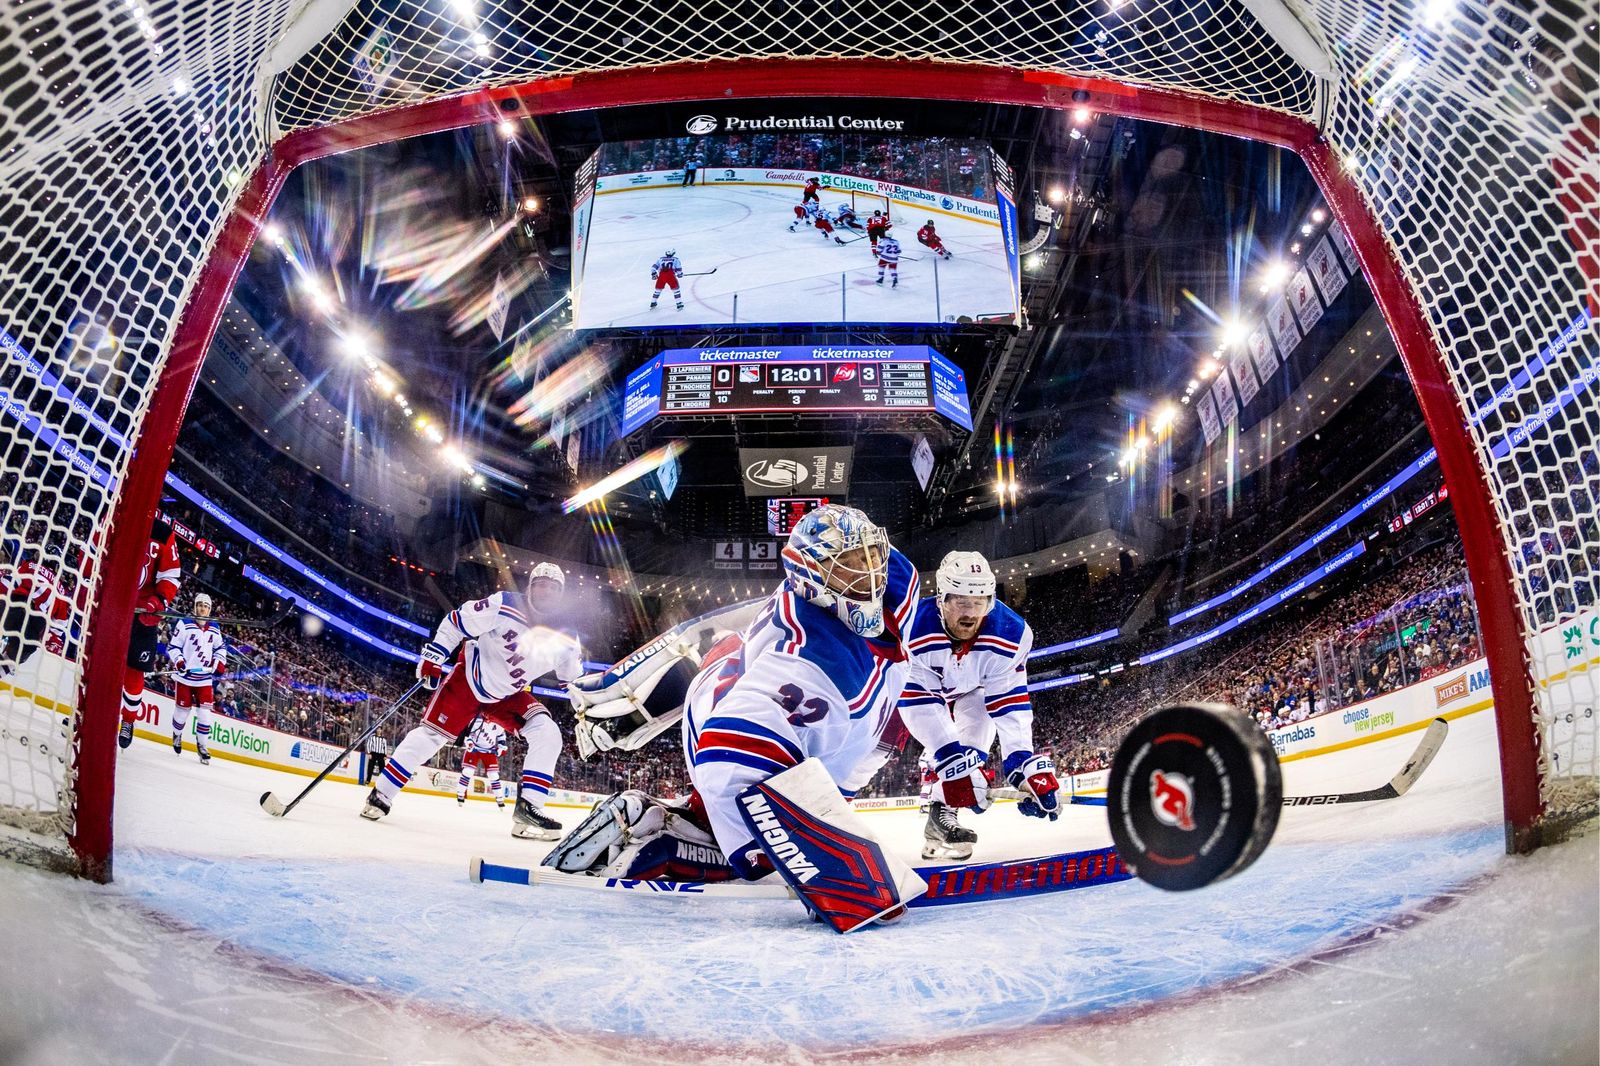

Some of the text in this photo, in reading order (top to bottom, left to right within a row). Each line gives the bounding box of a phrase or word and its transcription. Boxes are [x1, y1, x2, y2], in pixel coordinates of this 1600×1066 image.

[725, 116, 904, 130] Prudential Center
[765, 171, 804, 181] Campbell's
[833, 177, 874, 192] Citizens
[886, 245, 898, 254] 23
[700, 350, 781, 361] ticketmaster
[812, 348, 894, 359] ticketmaster
[717, 369, 730, 382] 0
[771, 368, 821, 382] 12:01
[863, 368, 875, 381] 3
[793, 396, 801, 404] 3
[812, 455, 828, 490] Prudential
[830, 462, 845, 484] Center
[149, 541, 160, 558] C
[724, 543, 735, 558] 4
[758, 543, 768, 558] 3
[970, 564, 981, 573] 13
[473, 599, 489, 612] 5
[208, 634, 214, 643] A
[611, 631, 679, 677] VAUGHN
[1439, 681, 1464, 701] MIKE'S
[1343, 707, 1369, 724] choose
[1355, 710, 1394, 732] new jersey
[1269, 725, 1315, 746] Barnabas
[855, 801, 888, 809] verizon
[741, 793, 820, 884] VAUGHN
